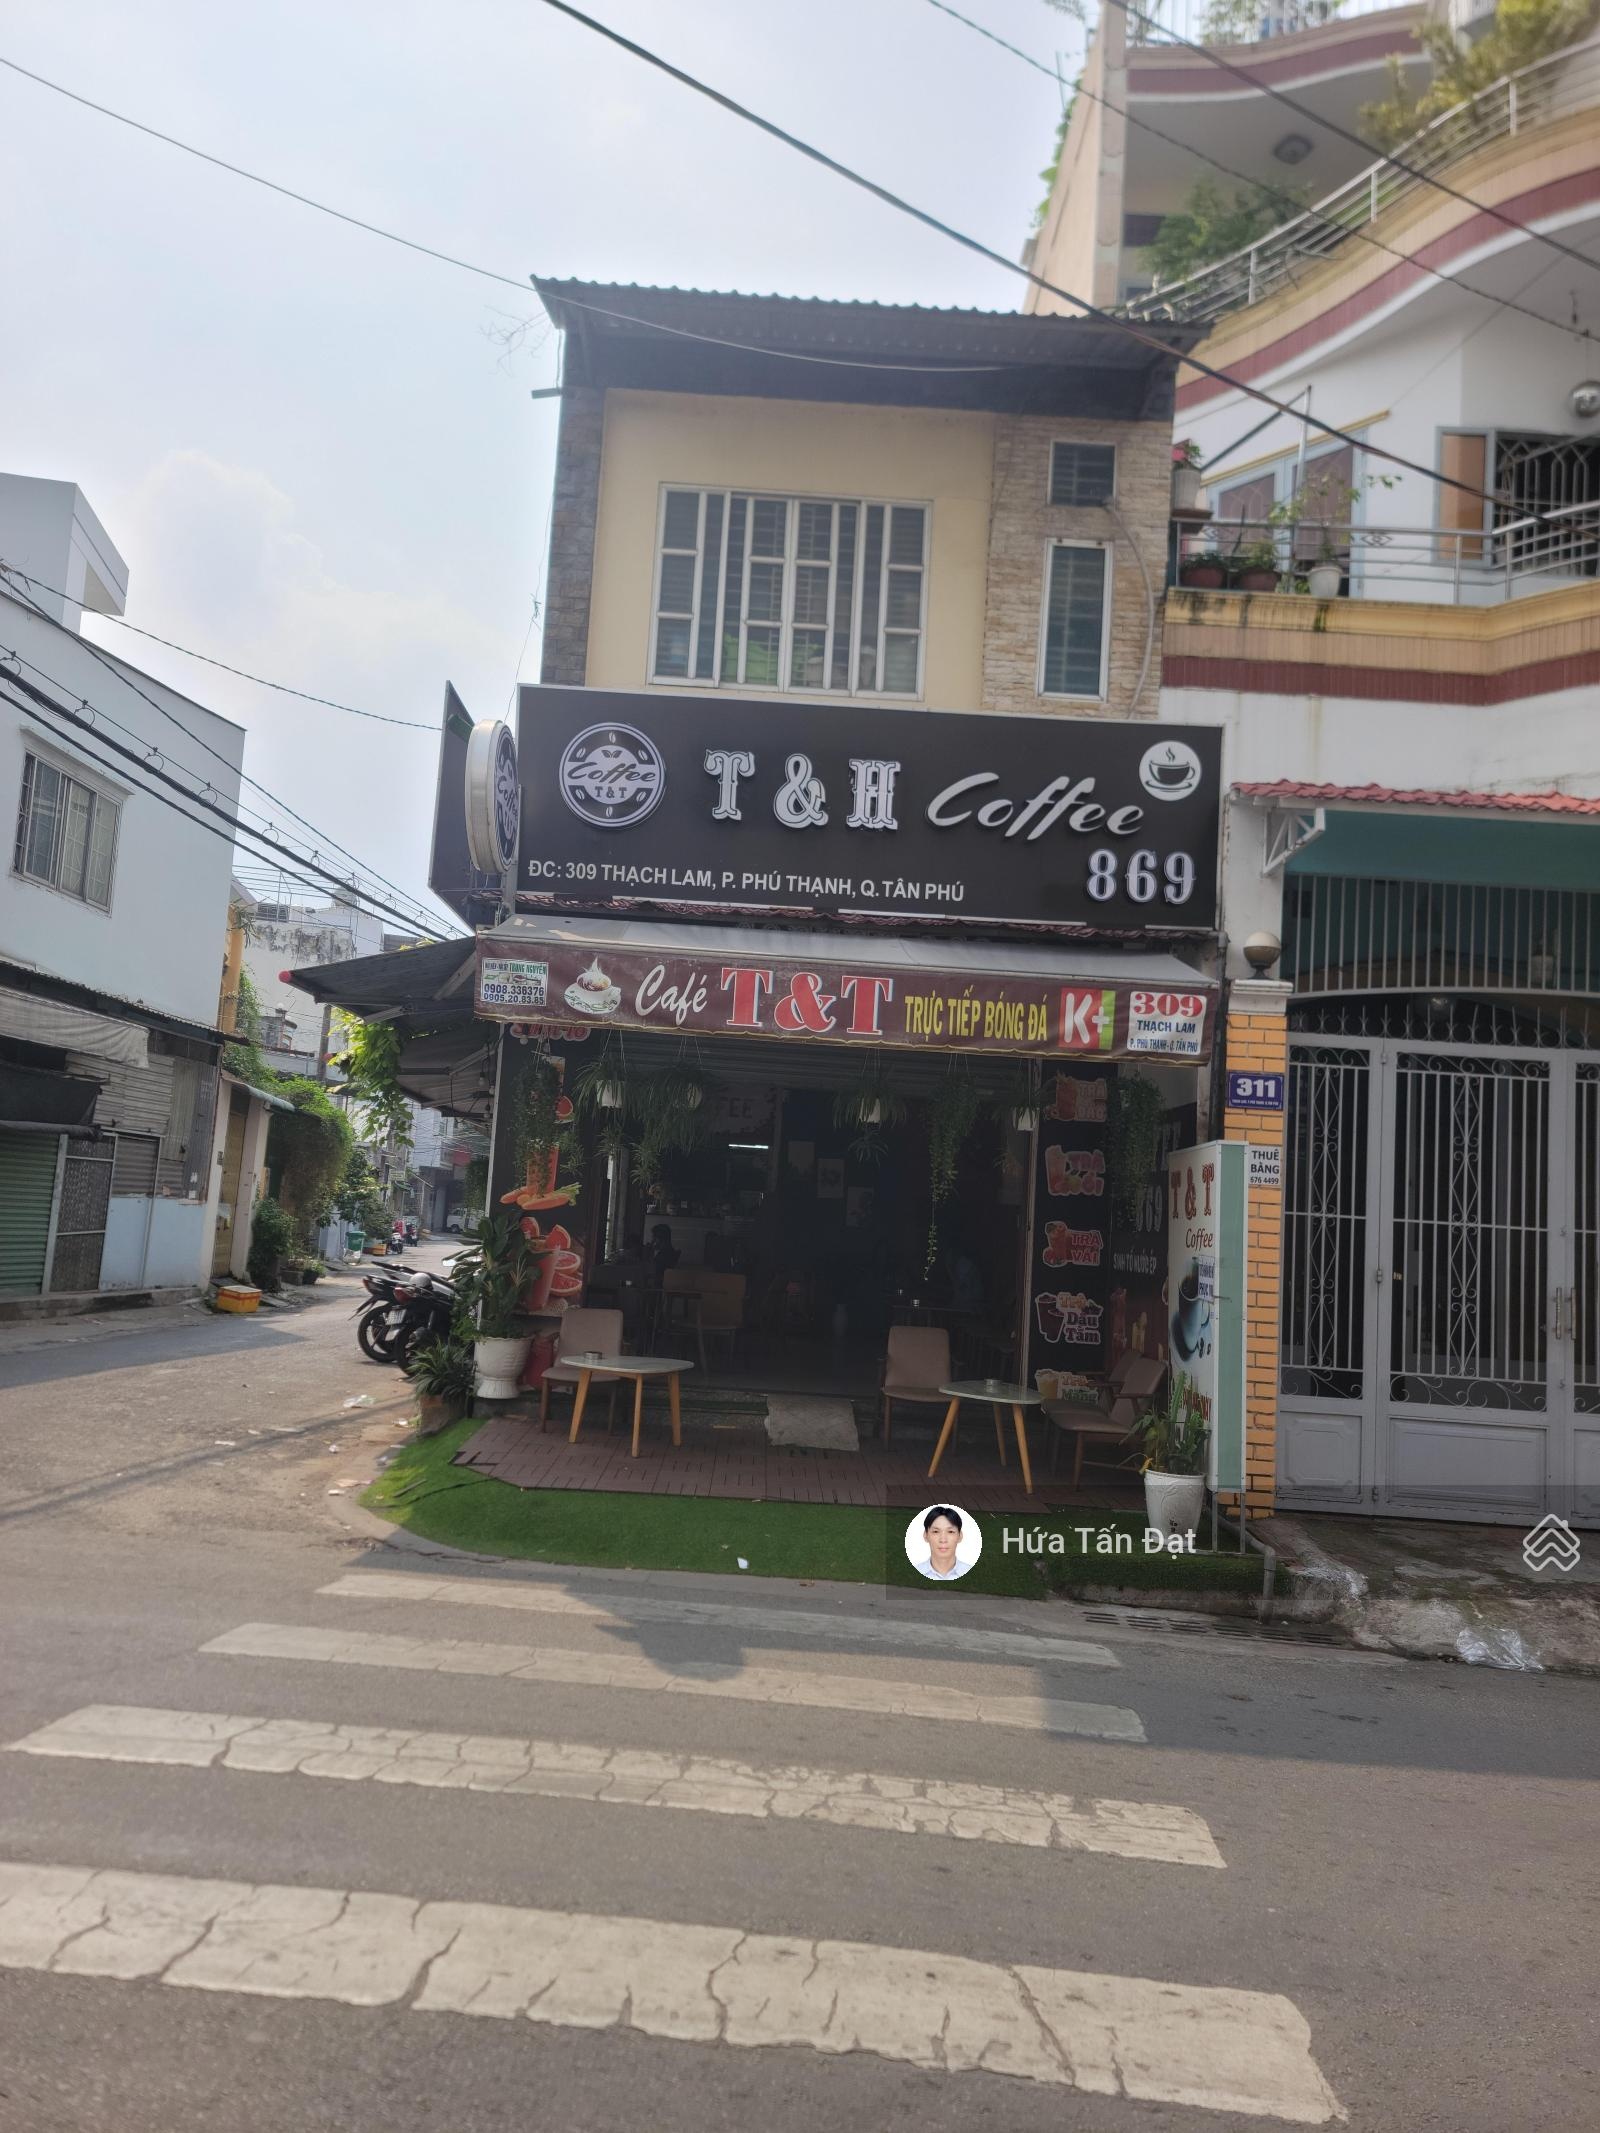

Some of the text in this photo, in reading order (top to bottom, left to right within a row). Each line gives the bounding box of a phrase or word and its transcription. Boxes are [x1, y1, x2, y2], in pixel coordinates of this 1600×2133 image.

[567, 762, 656, 784] Coffee
[594, 786, 627, 798] T & T
[703, 749, 1144, 840] T & H Coffee
[528, 860, 964, 902] ĐC: 309 THẠCH LAM, P. PHÚ THẠNH, Q. TÂN PHÚ
[1086, 849, 1196, 905] 869
[484, 983, 545, 996] 0908.336376
[635, 964, 708, 1026] Café
[904, 984, 1048, 1042] TRỰC TIẾP BÓNG ĐÁ
[1133, 993, 1203, 1017] 309
[1064, 992, 1110, 1045] K+
[1136, 1020, 1195, 1034] THẠCH LAM
[1236, 1077, 1275, 1098] 311
[1251, 1149, 1280, 1161] THUÊ
[1171, 1162, 1215, 1220] T & T
[1185, 1228, 1213, 1251] Coffee
